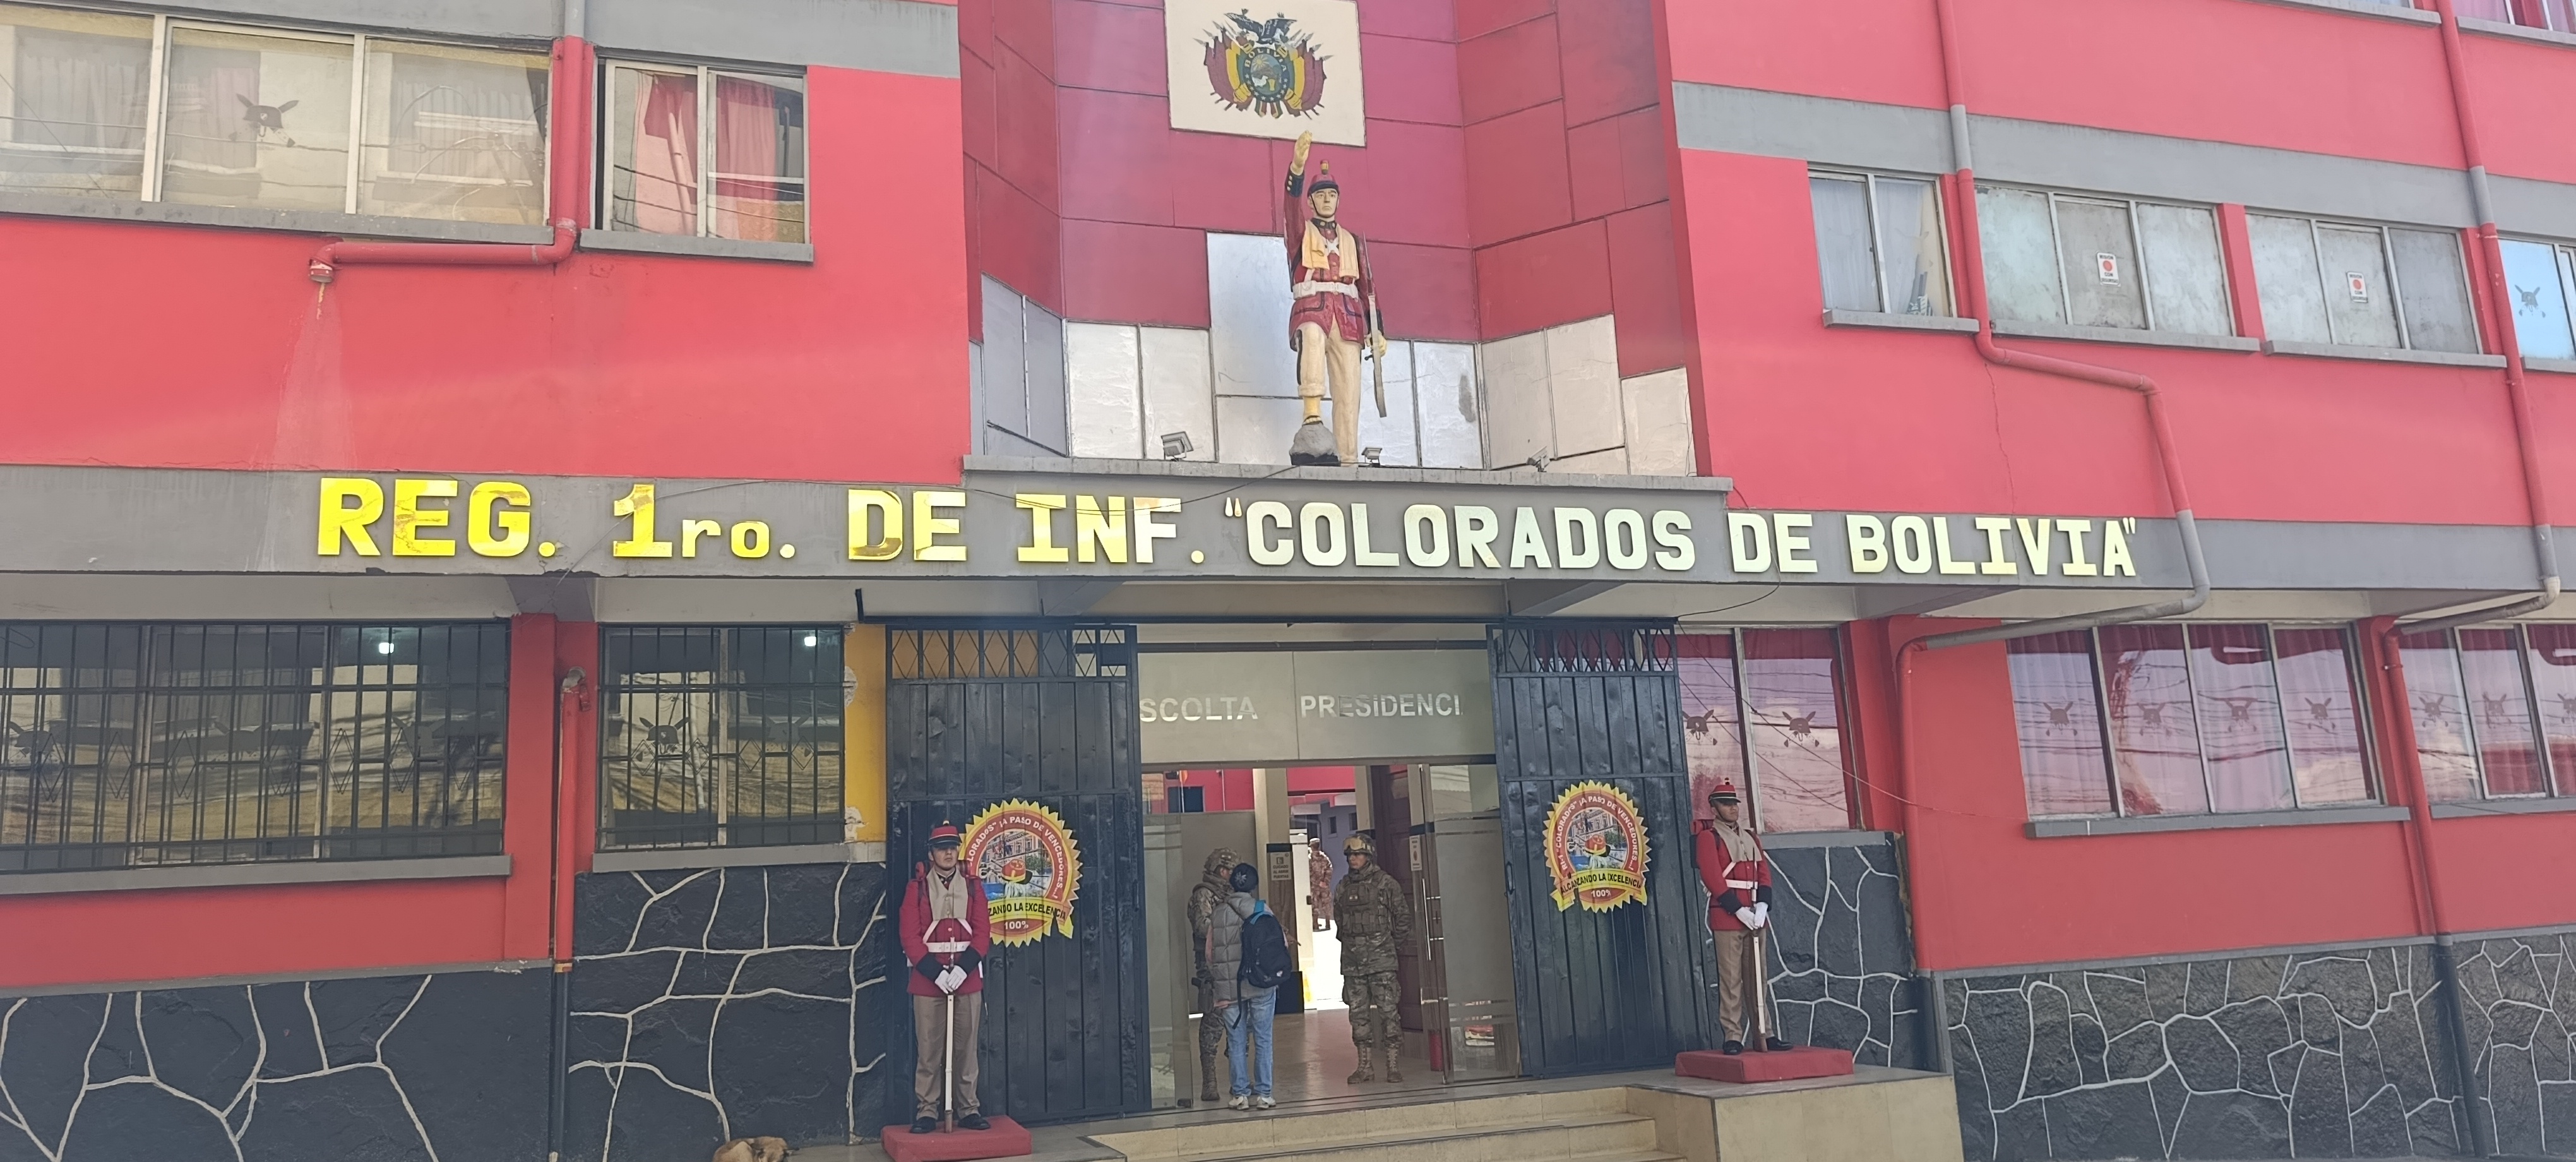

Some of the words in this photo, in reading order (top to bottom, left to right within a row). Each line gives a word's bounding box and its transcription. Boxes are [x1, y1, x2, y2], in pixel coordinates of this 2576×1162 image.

[1244, 48, 1287, 71] BOLIVIA
[318, 477, 556, 558] REG.
[612, 483, 796, 559] 1ro.
[848, 489, 967, 561] DE
[1015, 493, 1205, 564] INF.
[1225, 496, 1696, 571] "COLORADOS
[1727, 512, 1818, 573] DE
[1846, 513, 2137, 577] BOLIVIA"
[1139, 696, 1258, 722] SCOLTA
[1300, 693, 1463, 719] PRESIDENCI
[1588, 796, 1606, 805] PASO
[1607, 800, 1618, 810] DE
[967, 822, 997, 867] LORADOS"
[1010, 815, 1032, 825] PASO
[1032, 821, 1045, 832] DE
[1561, 873, 1597, 894] ALCANZANDO
[1599, 873, 1607, 882] LA
[1590, 889, 1611, 897] 100%
[1014, 902, 1023, 911] LA
[1025, 902, 1066, 921] EXCELENCIA
[1005, 920, 1029, 930] 100%
